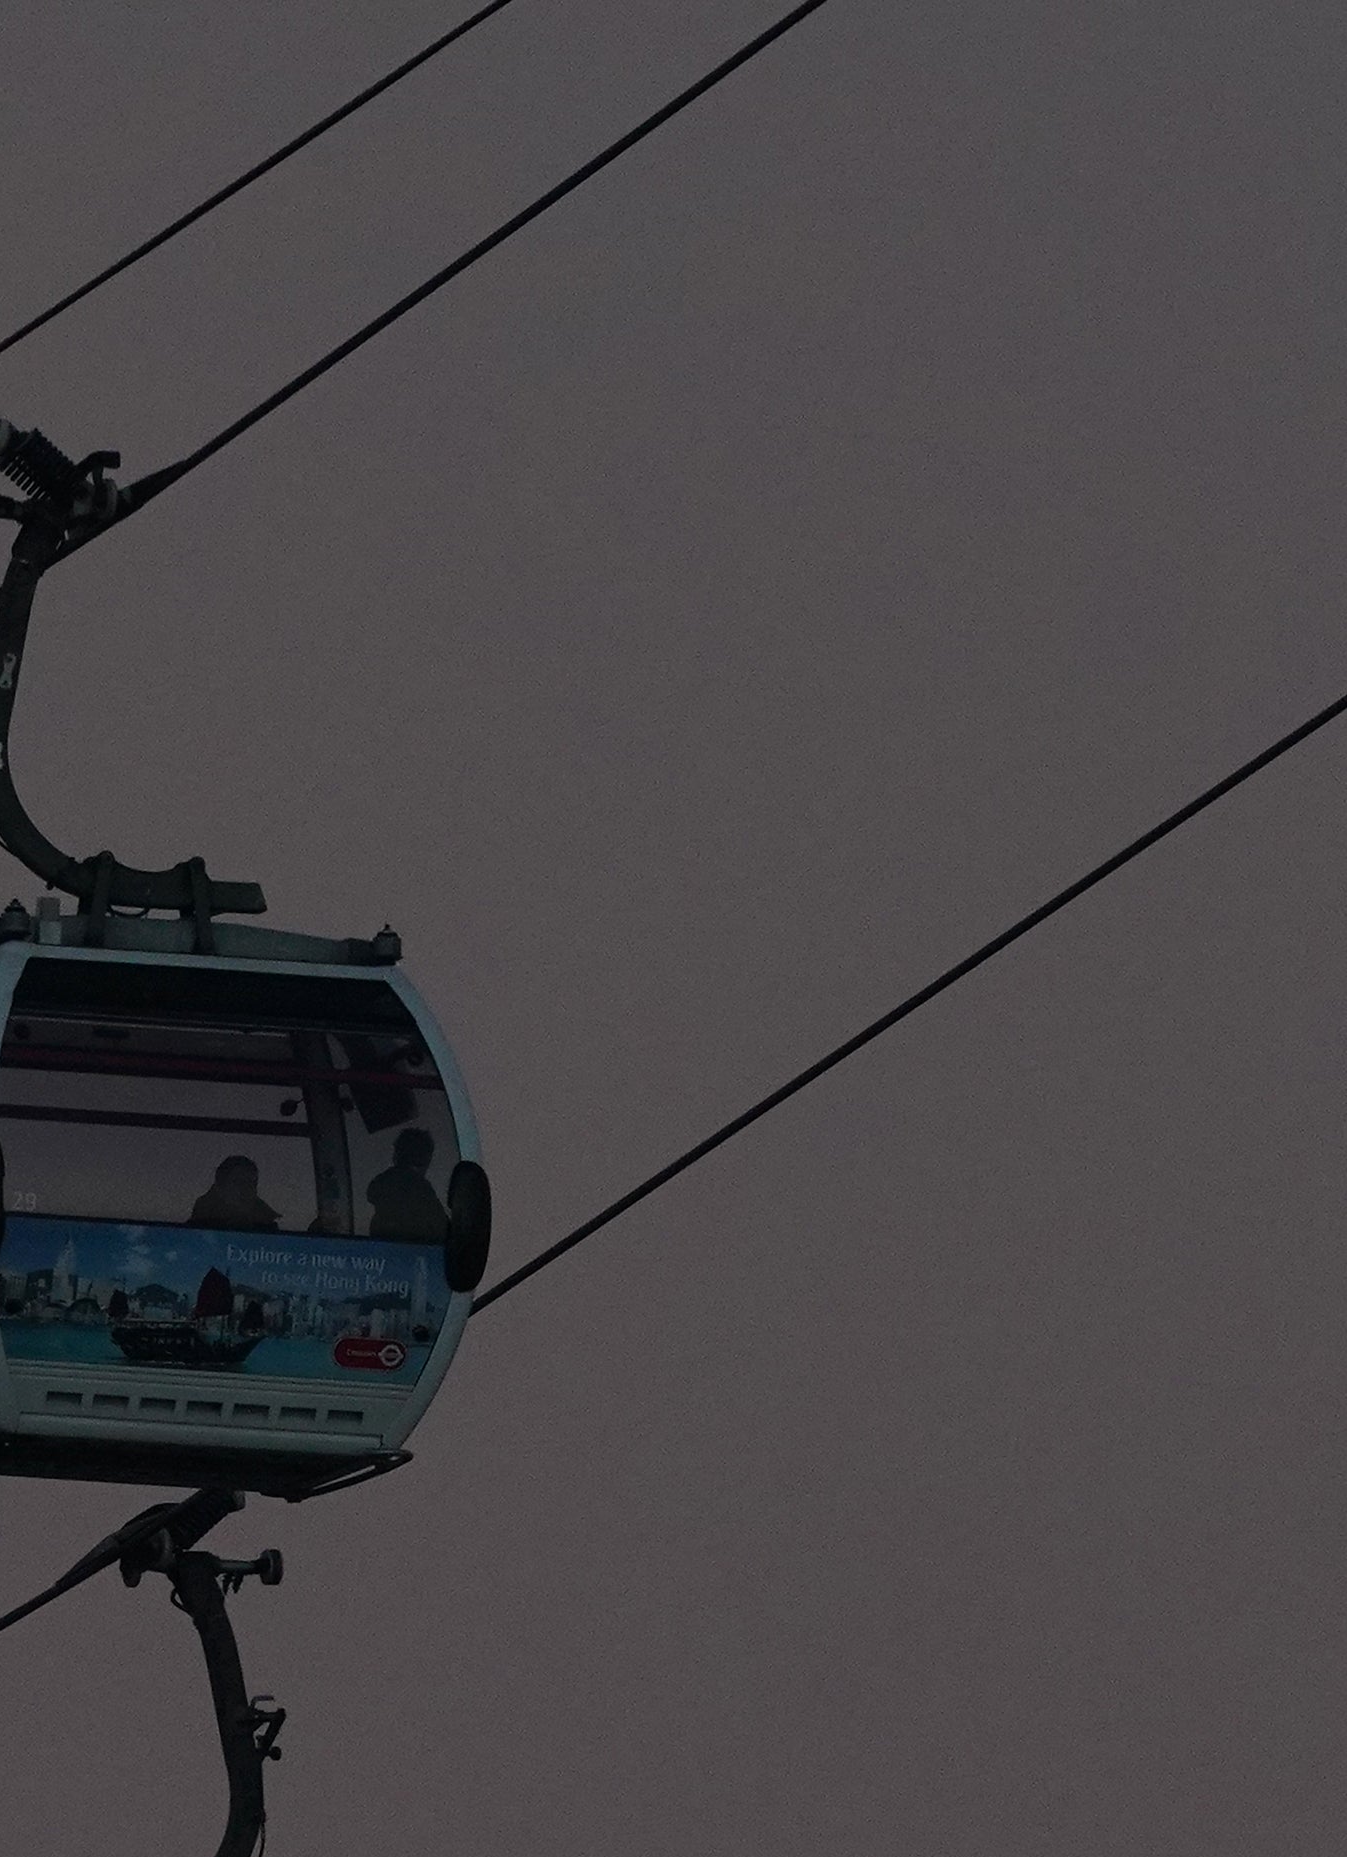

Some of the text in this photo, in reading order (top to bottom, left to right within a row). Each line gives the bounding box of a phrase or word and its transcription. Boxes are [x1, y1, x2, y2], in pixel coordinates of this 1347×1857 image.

[226, 1243, 387, 1275] Explore a new way
[261, 1270, 279, 1284] to
[316, 1272, 360, 1293] Hong
[364, 1274, 409, 1298] Kong
